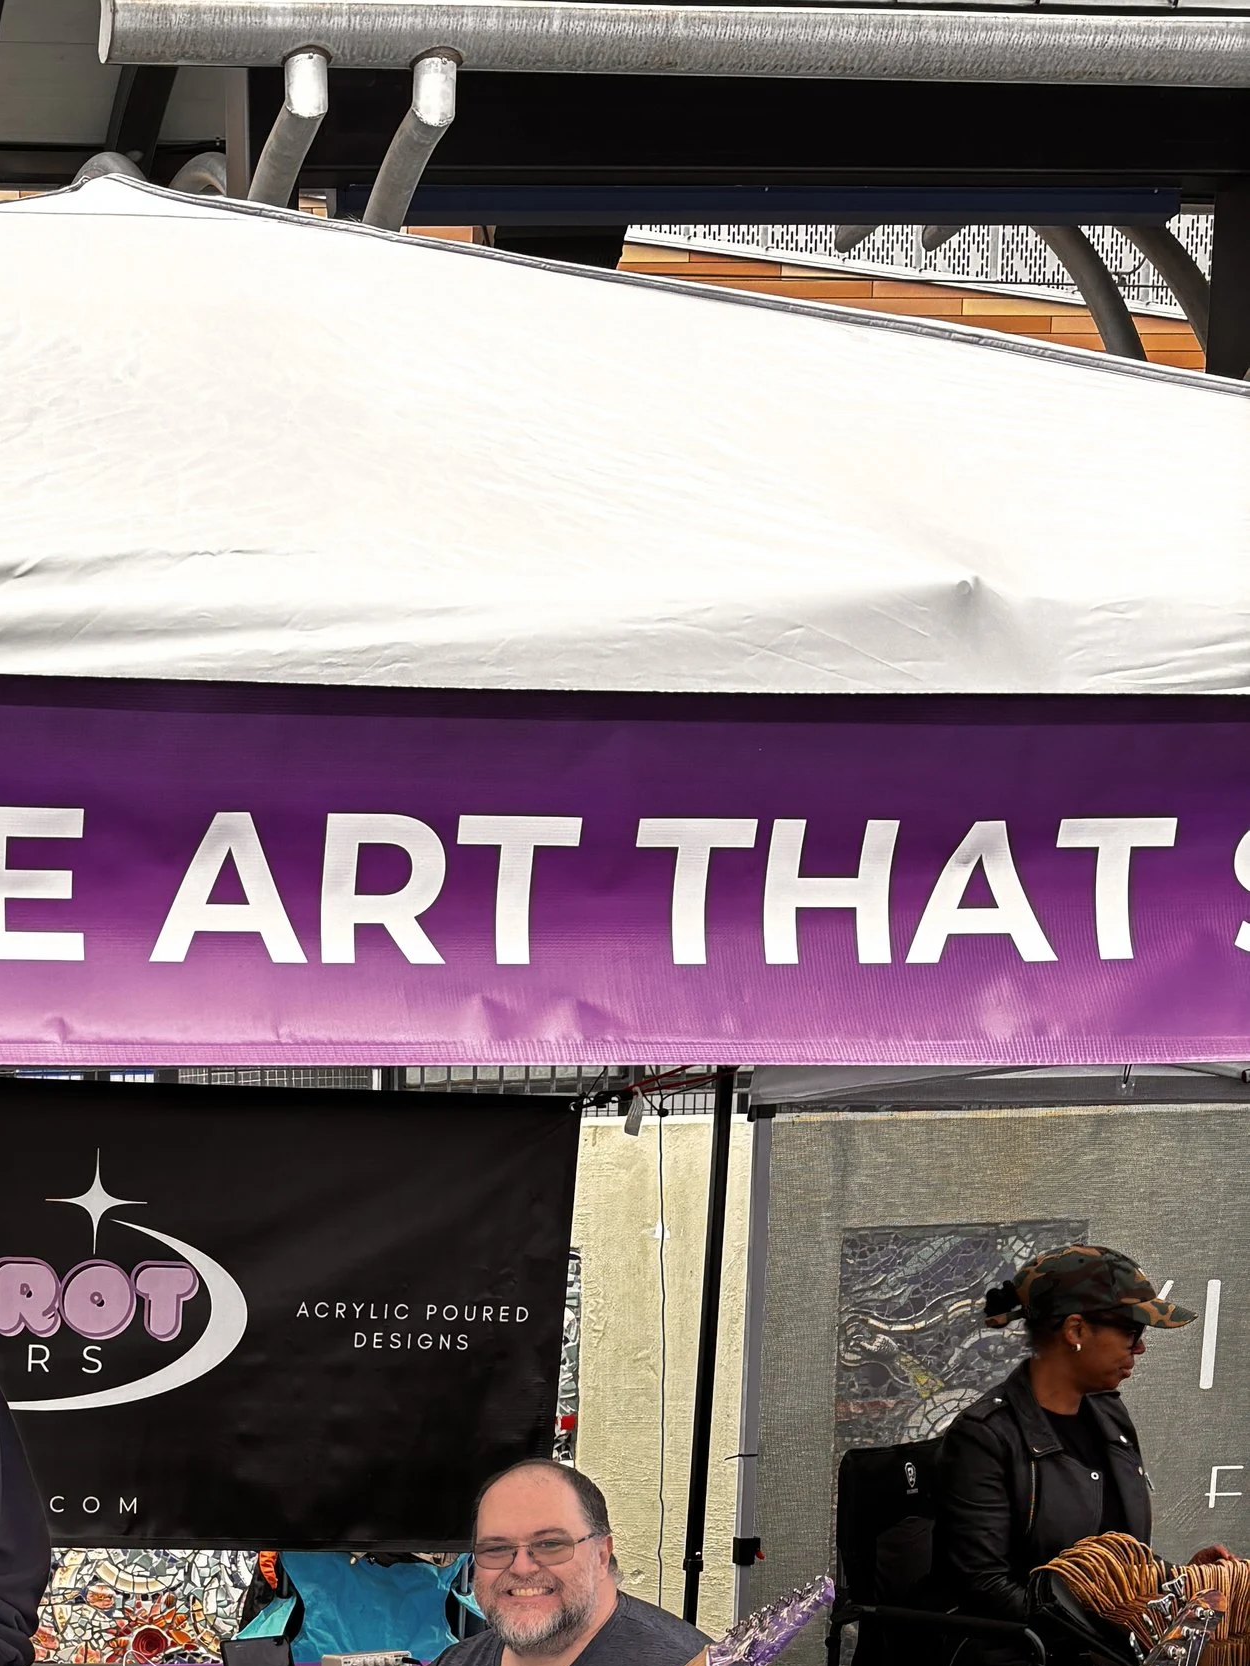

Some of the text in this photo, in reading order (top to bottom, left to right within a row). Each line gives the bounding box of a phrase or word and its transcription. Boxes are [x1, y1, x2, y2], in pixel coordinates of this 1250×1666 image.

[149, 811, 583, 965] ART
[635, 816, 1178, 965] THAT
[296, 1301, 530, 1323] ACRYLIC POURED
[353, 1332, 470, 1352] DESIGNS
